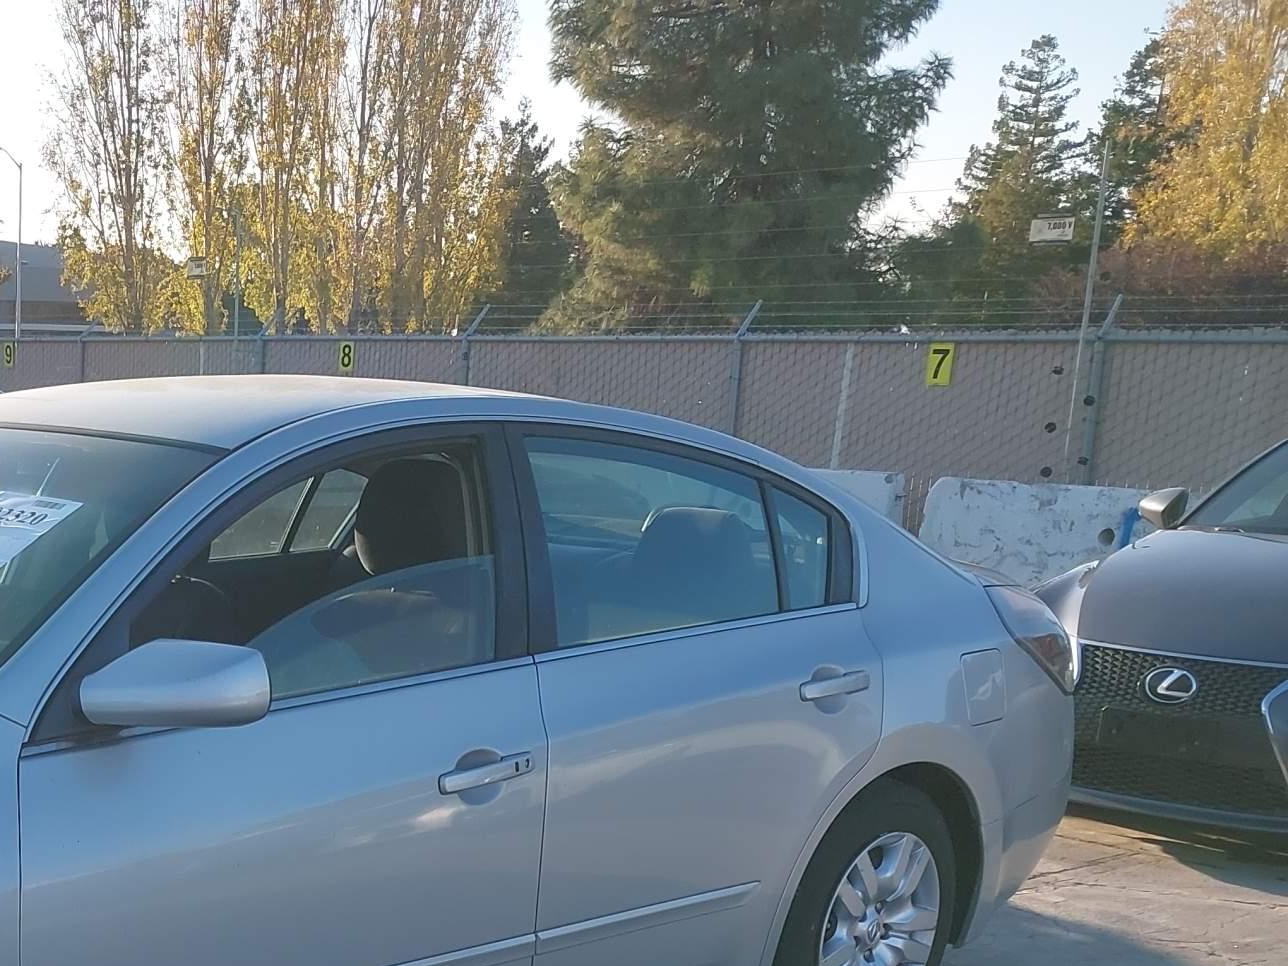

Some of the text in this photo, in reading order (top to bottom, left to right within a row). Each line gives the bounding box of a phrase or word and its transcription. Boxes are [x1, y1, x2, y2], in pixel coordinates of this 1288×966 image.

[4, 344, 13, 364] 9
[341, 344, 352, 368] 8
[932, 348, 951, 380] 7
